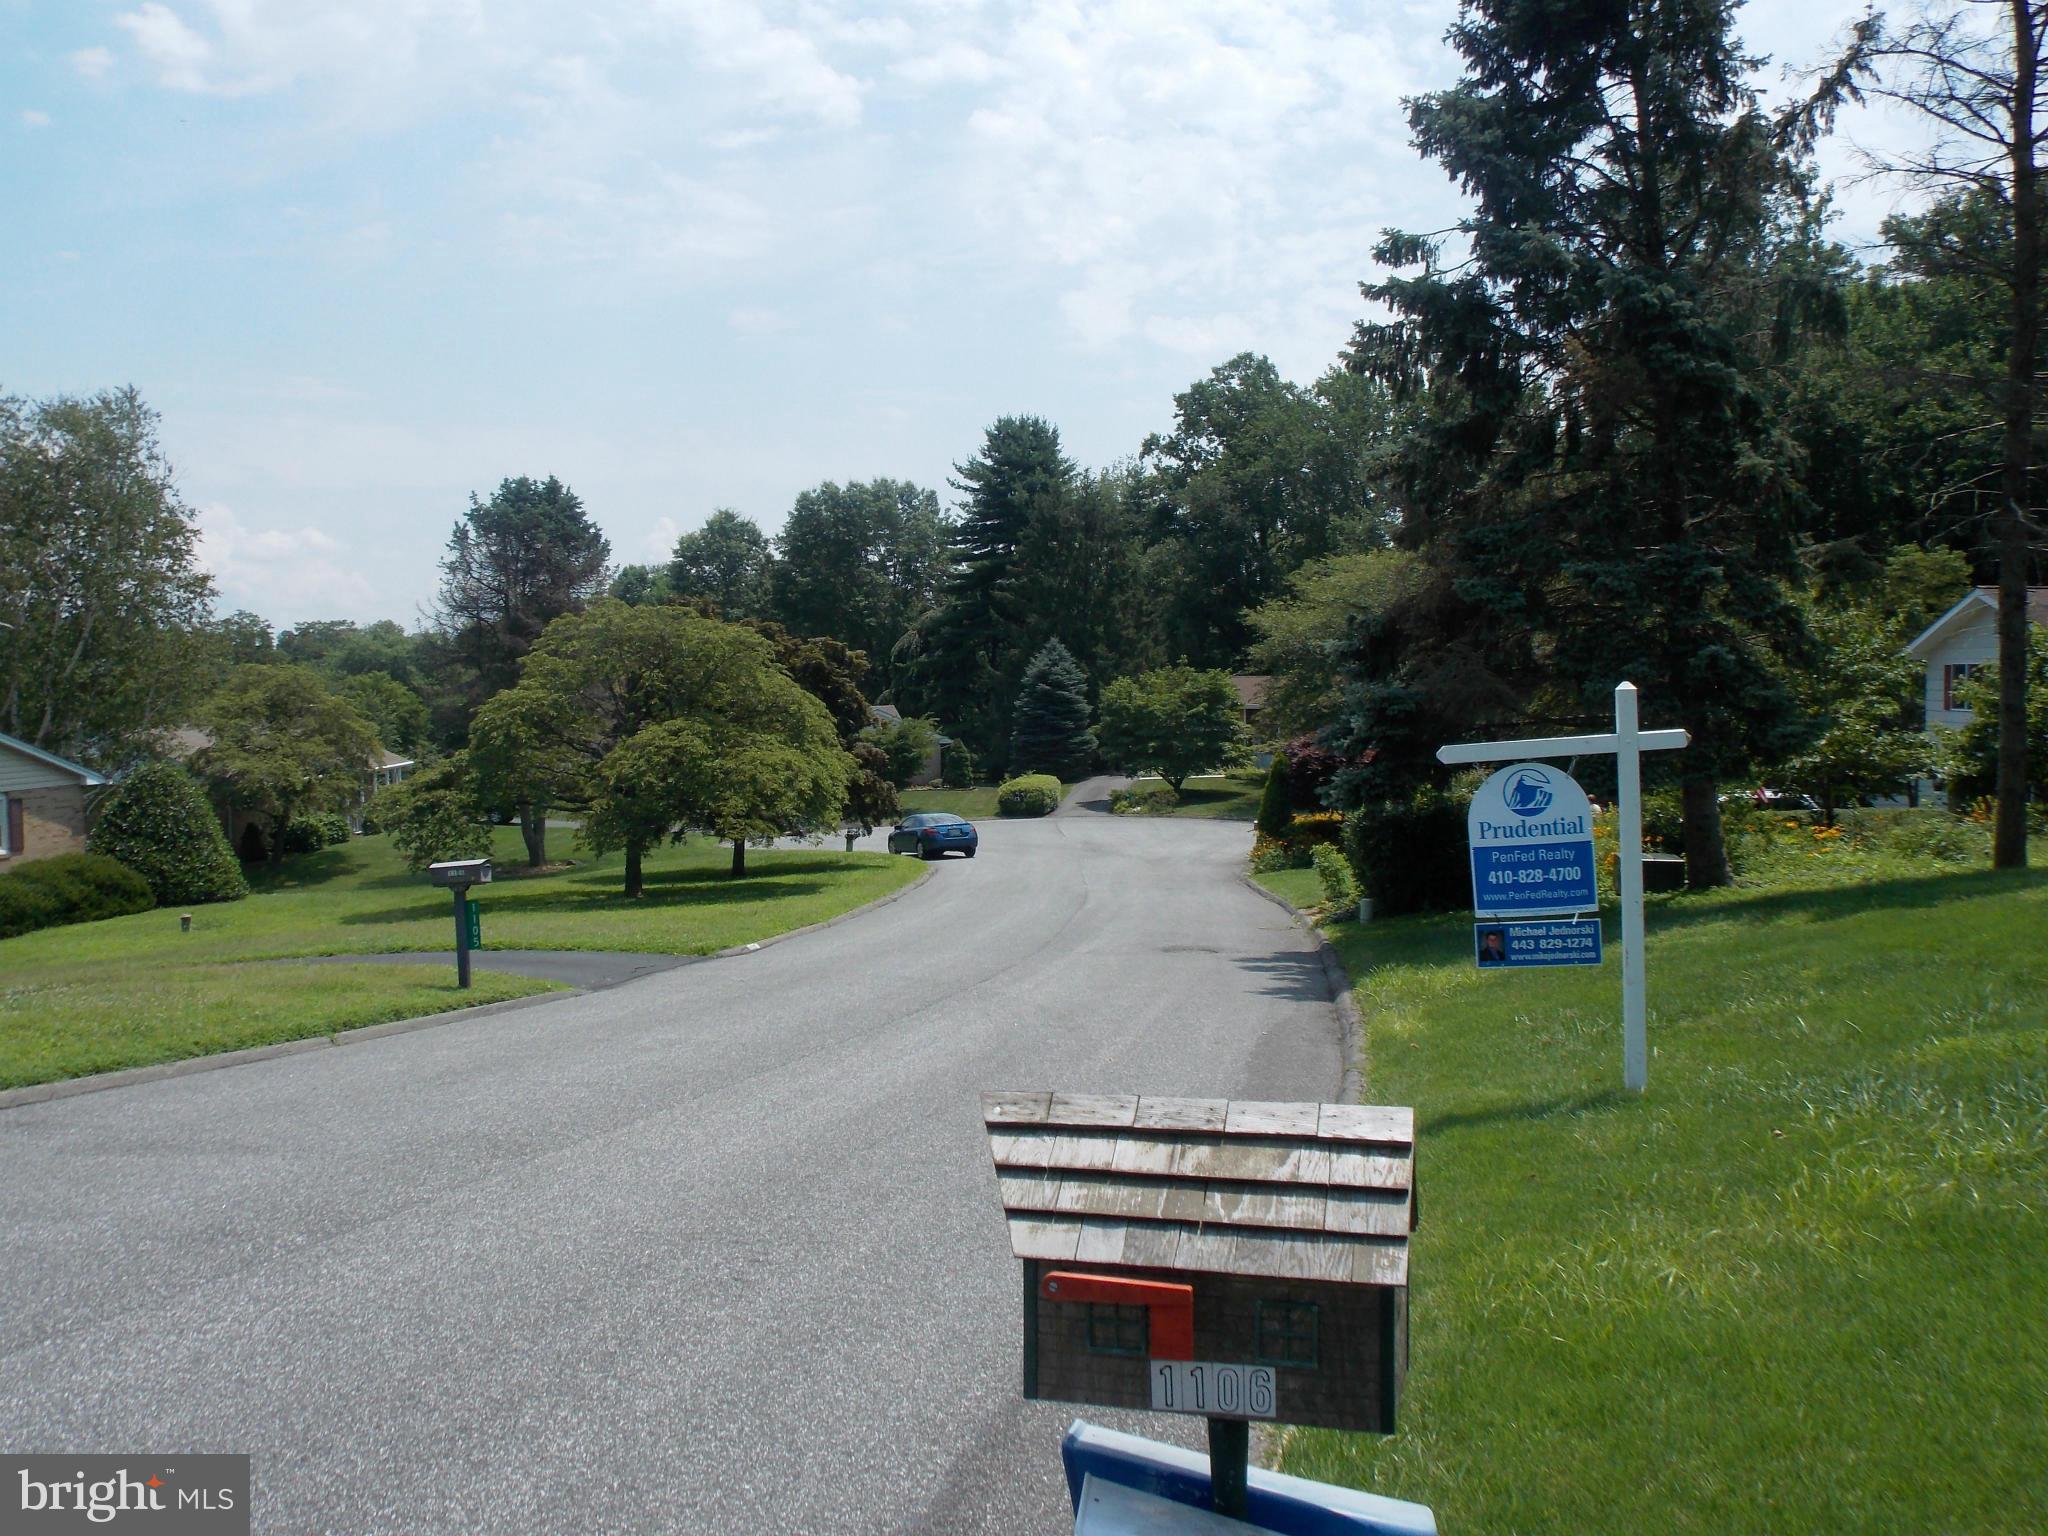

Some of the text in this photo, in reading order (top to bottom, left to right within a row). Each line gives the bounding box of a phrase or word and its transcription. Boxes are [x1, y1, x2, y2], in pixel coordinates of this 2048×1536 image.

[1479, 816, 1585, 840] Prudential
[1492, 848, 1575, 863] PenFed Realty
[1488, 866, 1581, 885] 410-828-4700
[1483, 888, 1589, 901] www.PenFedRealty.com
[471, 903, 480, 947] 1105
[1509, 926, 1547, 937] Michael
[1511, 937, 1593, 950] 443 829-1274
[1159, 1364, 1272, 1414] 1106
